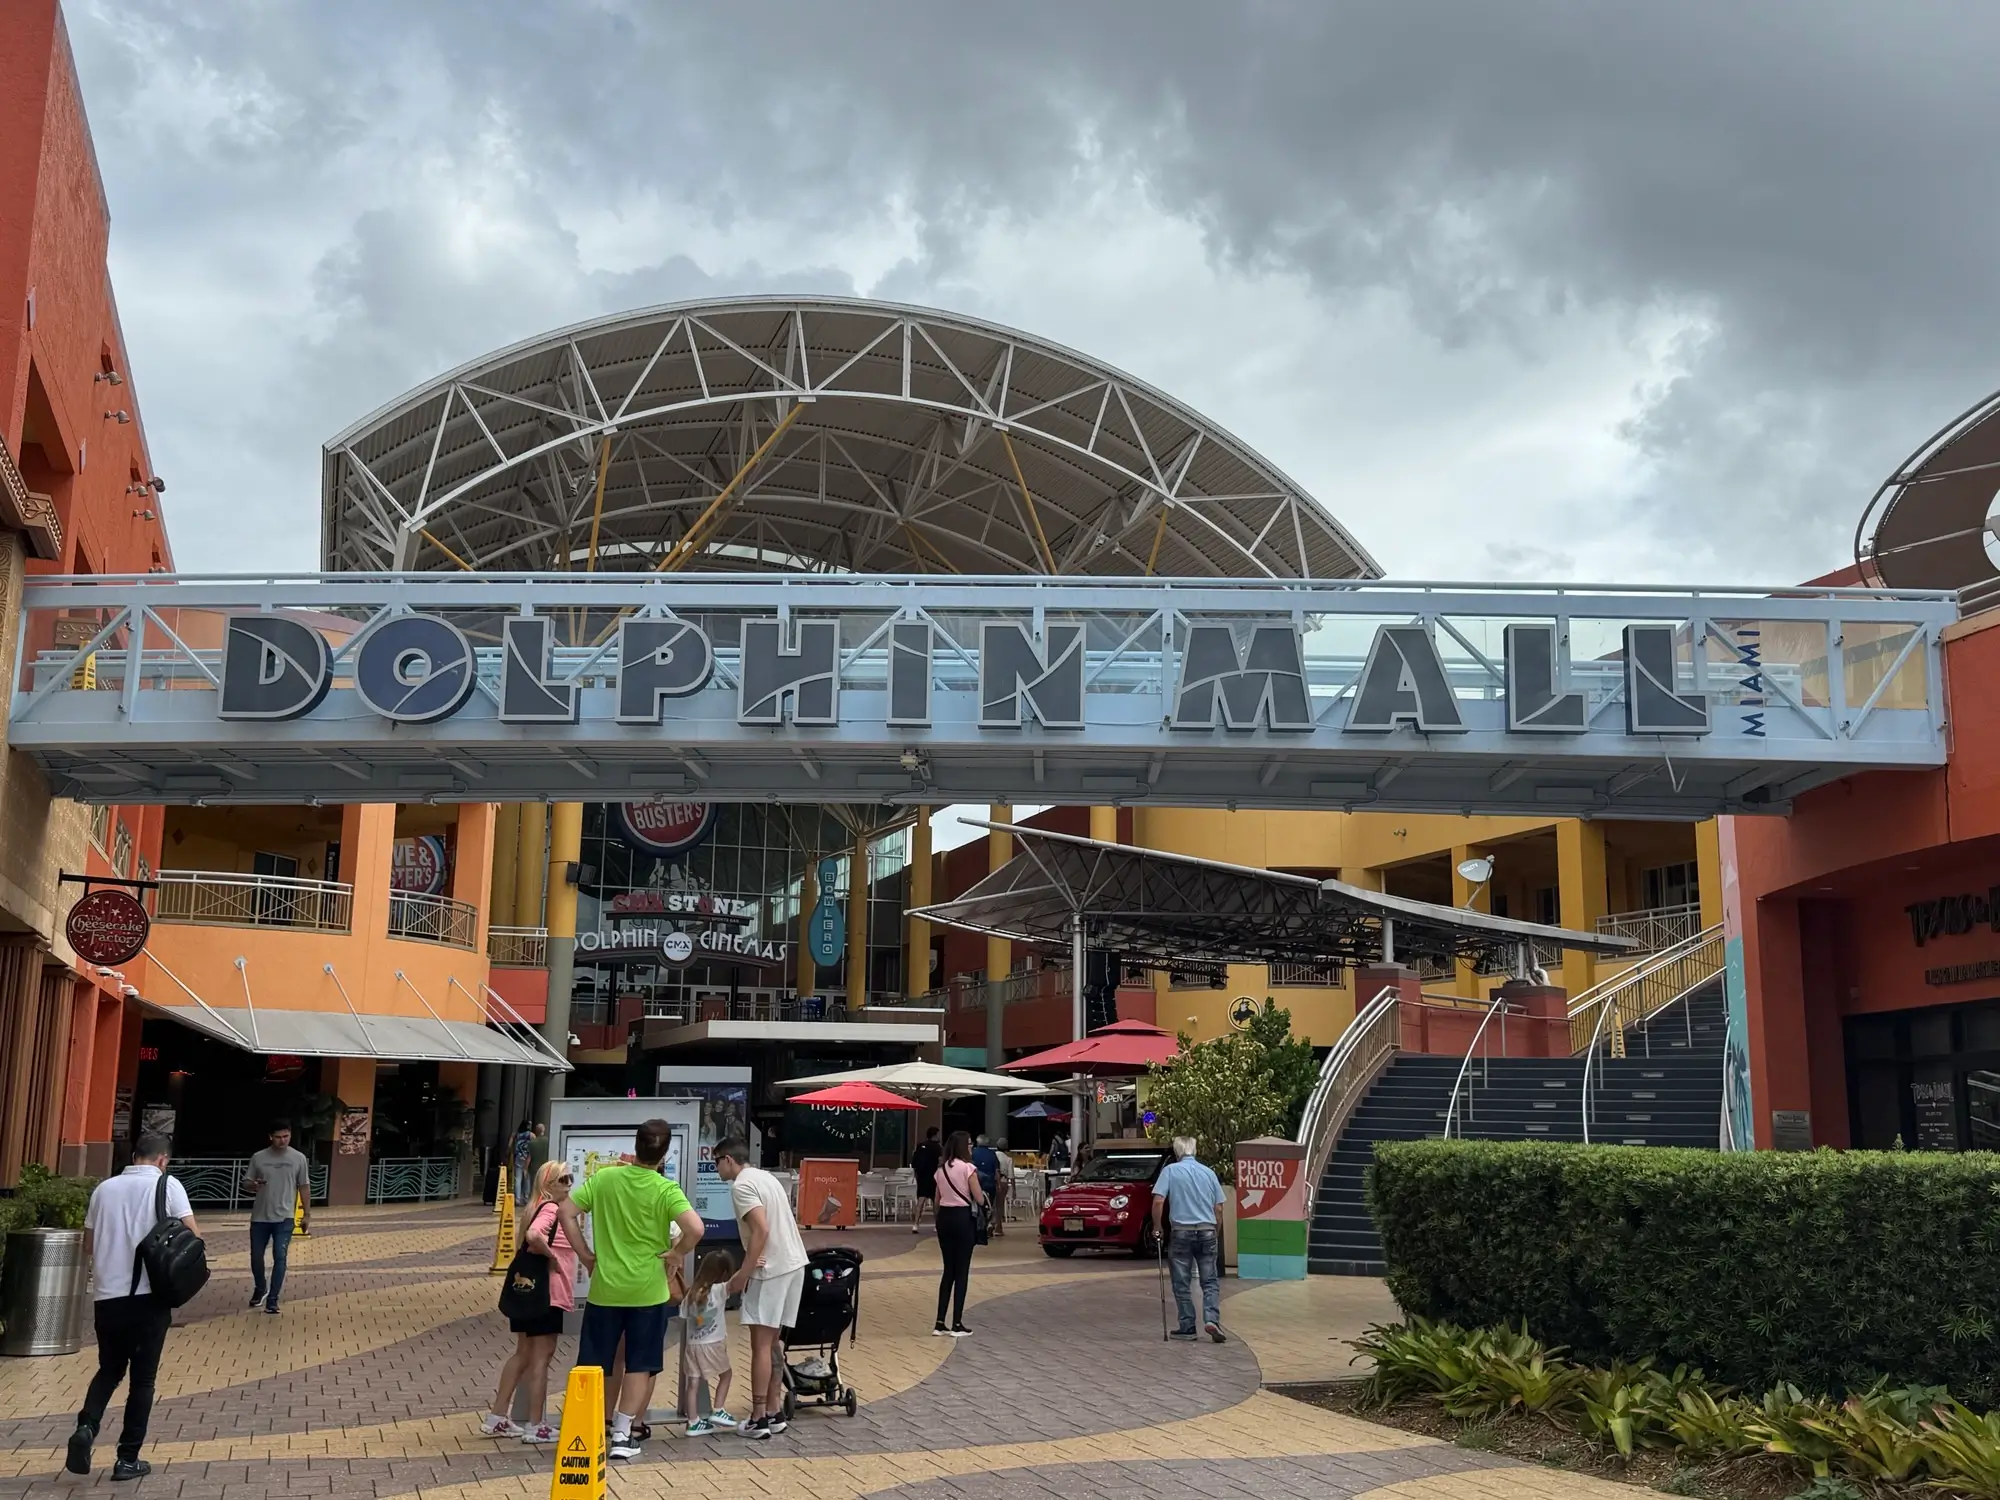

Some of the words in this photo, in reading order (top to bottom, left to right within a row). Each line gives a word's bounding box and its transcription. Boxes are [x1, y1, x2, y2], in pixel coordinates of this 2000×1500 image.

[218, 613, 1087, 731] DOLPHIN
[1169, 622, 1712, 735] MALL
[1737, 630, 1765, 737] MIAMI
[668, 894, 746, 915] STONE
[823, 872, 835, 954] BOWLERO
[72, 914, 143, 933] Cheesecake
[89, 929, 142, 949] Factory
[665, 940, 691, 949] CMX
[700, 930, 787, 962] CINEMAS
[1102, 1093, 1123, 1103] OPEN
[822, 1120, 846, 1139] LATIN
[1238, 1160, 1285, 1176] PHOTO
[1238, 1174, 1287, 1188] MURAL
[561, 1456, 590, 1468] CAUTION
[559, 1473, 589, 1485] CUIDADO
